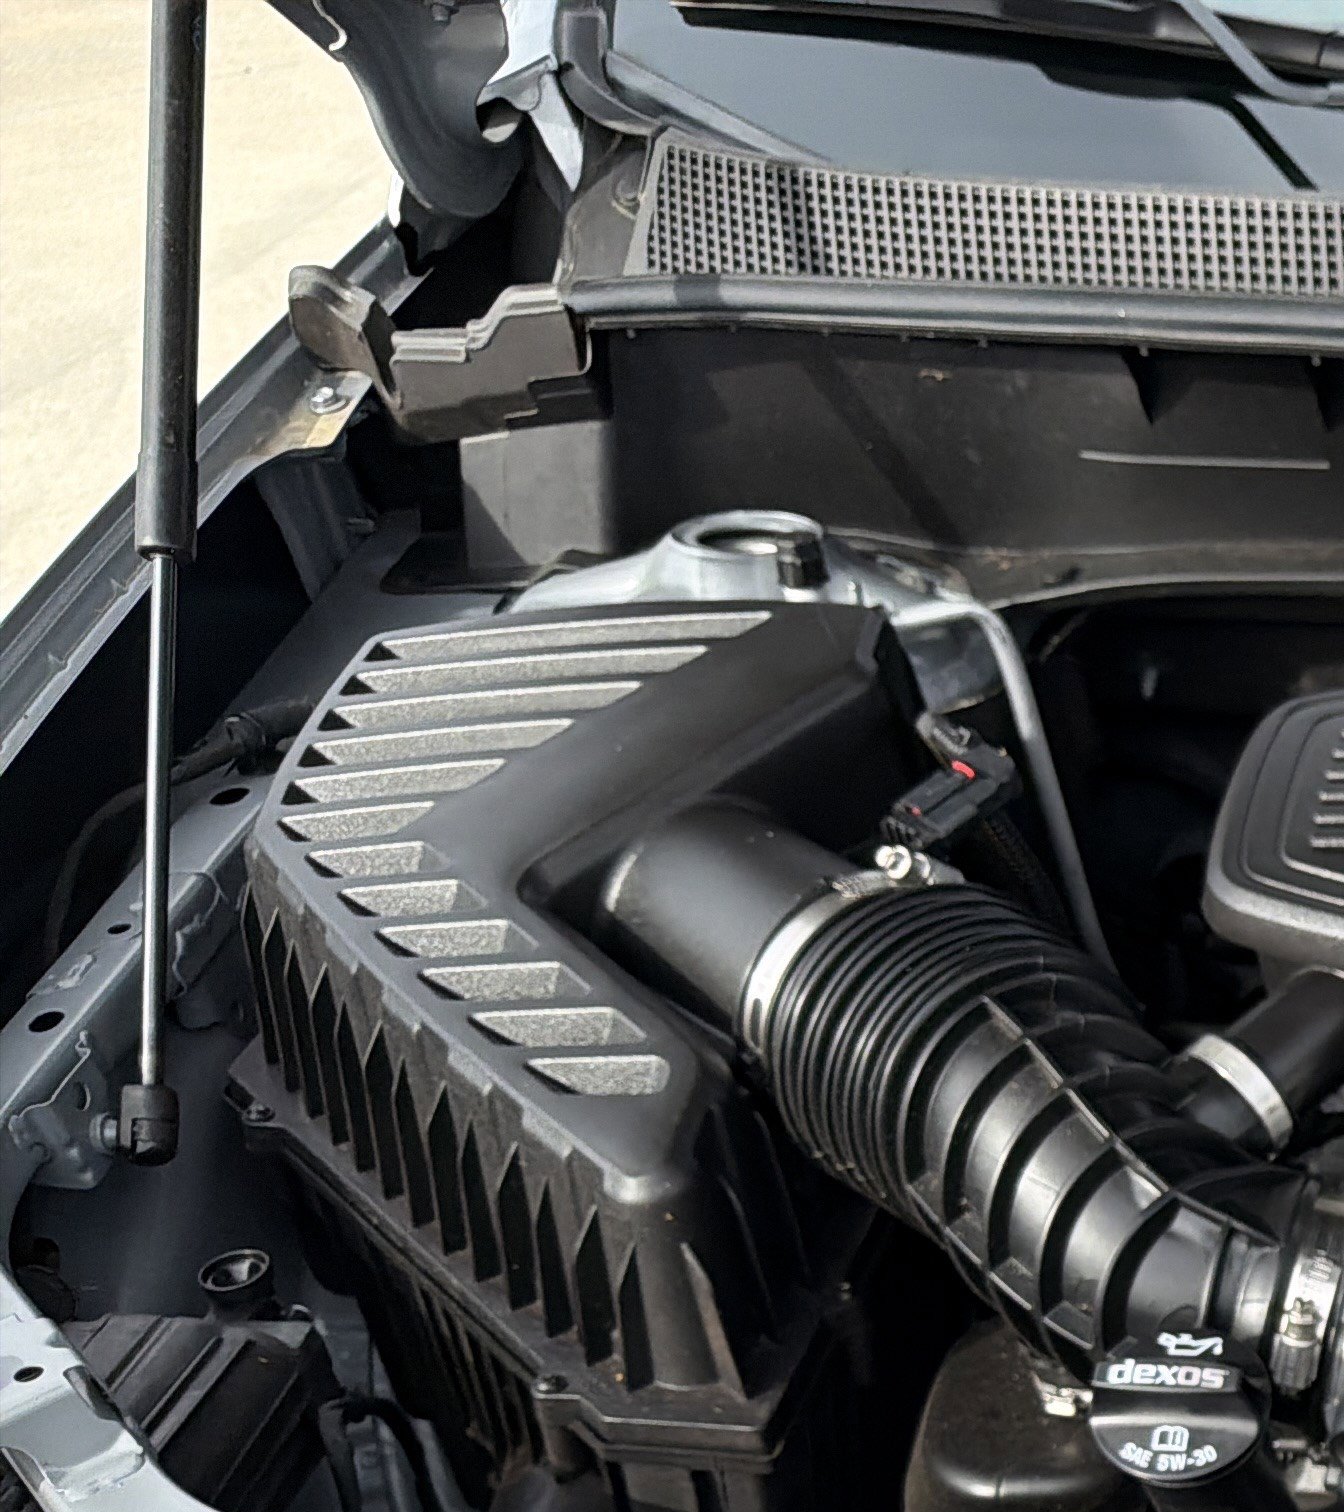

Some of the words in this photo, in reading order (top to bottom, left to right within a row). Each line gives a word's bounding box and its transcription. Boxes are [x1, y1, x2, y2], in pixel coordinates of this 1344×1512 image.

[1107, 1358, 1225, 1389] dexos
[1119, 1442, 1154, 1469] SAE
[1156, 1444, 1218, 1472] 5W-30
